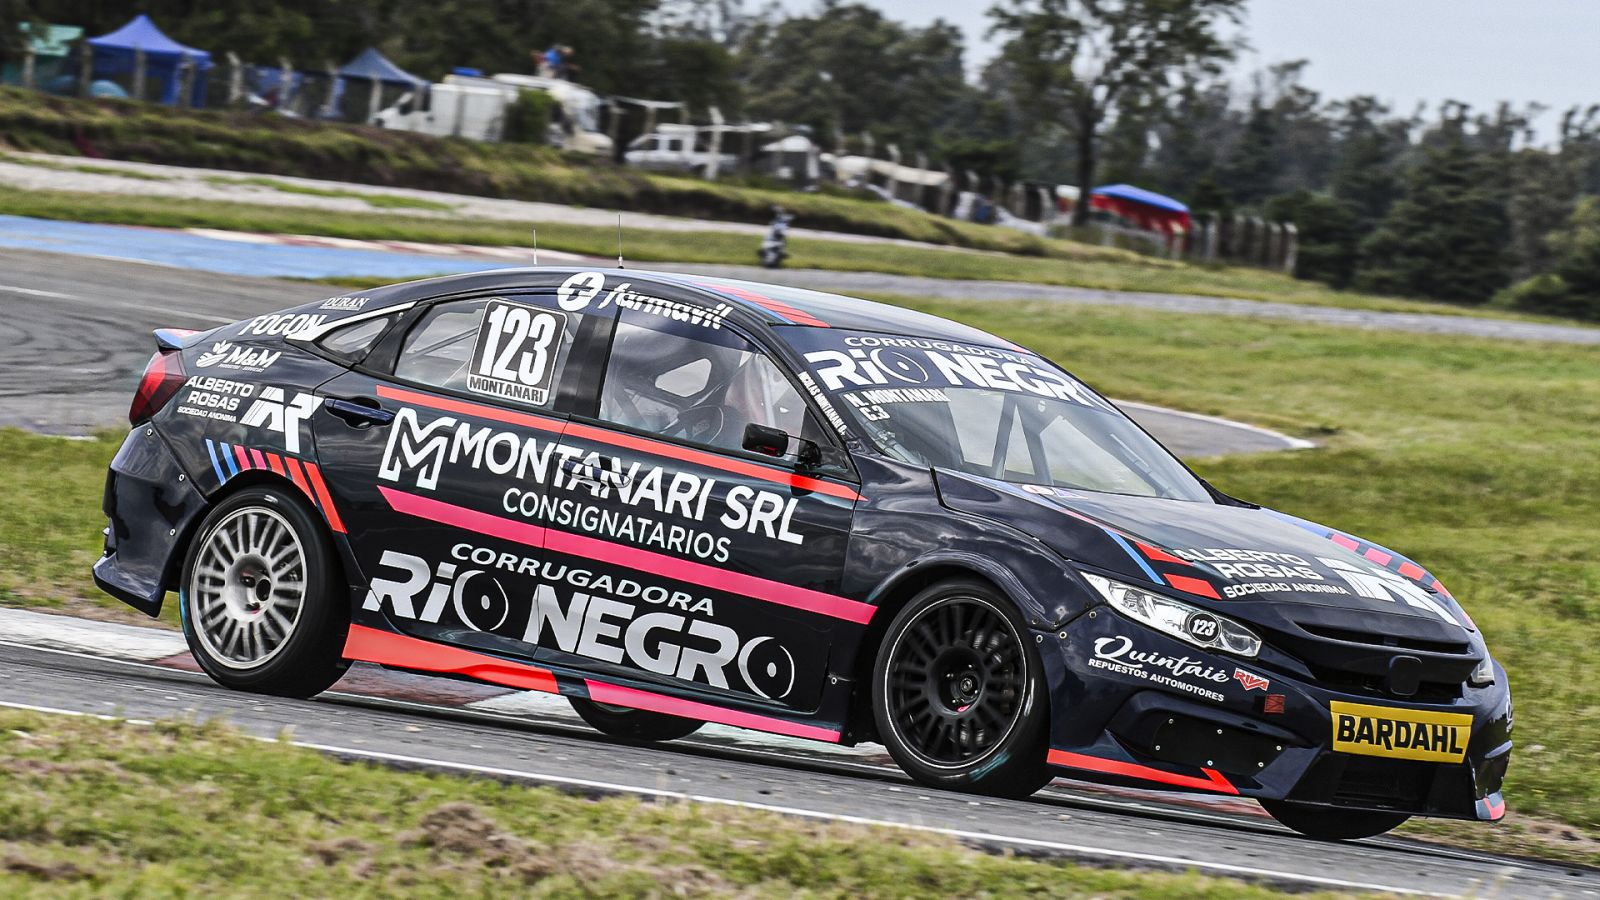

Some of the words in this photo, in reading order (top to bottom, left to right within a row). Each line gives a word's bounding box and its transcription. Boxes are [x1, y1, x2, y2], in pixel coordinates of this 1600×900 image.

[322, 297, 370, 308] DURAN
[598, 283, 733, 329] farmavil
[238, 314, 327, 336] FOGON
[479, 305, 556, 385] 123
[844, 336, 1038, 367] CORRUGADORA
[223, 346, 282, 368] M&M
[185, 375, 254, 397] ALBERTO
[469, 377, 544, 403] MONTANARI
[186, 391, 240, 412] ROSAS
[843, 393, 870, 407] N.
[861, 388, 951, 404] MONTANARI
[177, 406, 208, 417] SOCIEDAD
[207, 411, 237, 423] ANONIMA
[450, 422, 716, 520] MONTANARI
[720, 485, 804, 544] SRL
[503, 487, 731, 563] CONSIGNATARIOS
[1175, 549, 1310, 565] ALBERTO
[451, 543, 714, 616] CORRUGADORA
[1215, 563, 1324, 580] ROSAS
[1223, 582, 1293, 599] SOCIEDAD
[1294, 583, 1351, 595] ANONIMA
[1192, 619, 1217, 637] 123
[522, 584, 796, 702] NEGRO
[1088, 658, 1148, 679] REPUESTOS
[1150, 673, 1224, 702] AUTOMOTORES
[1337, 715, 1463, 754] BARDAHL
